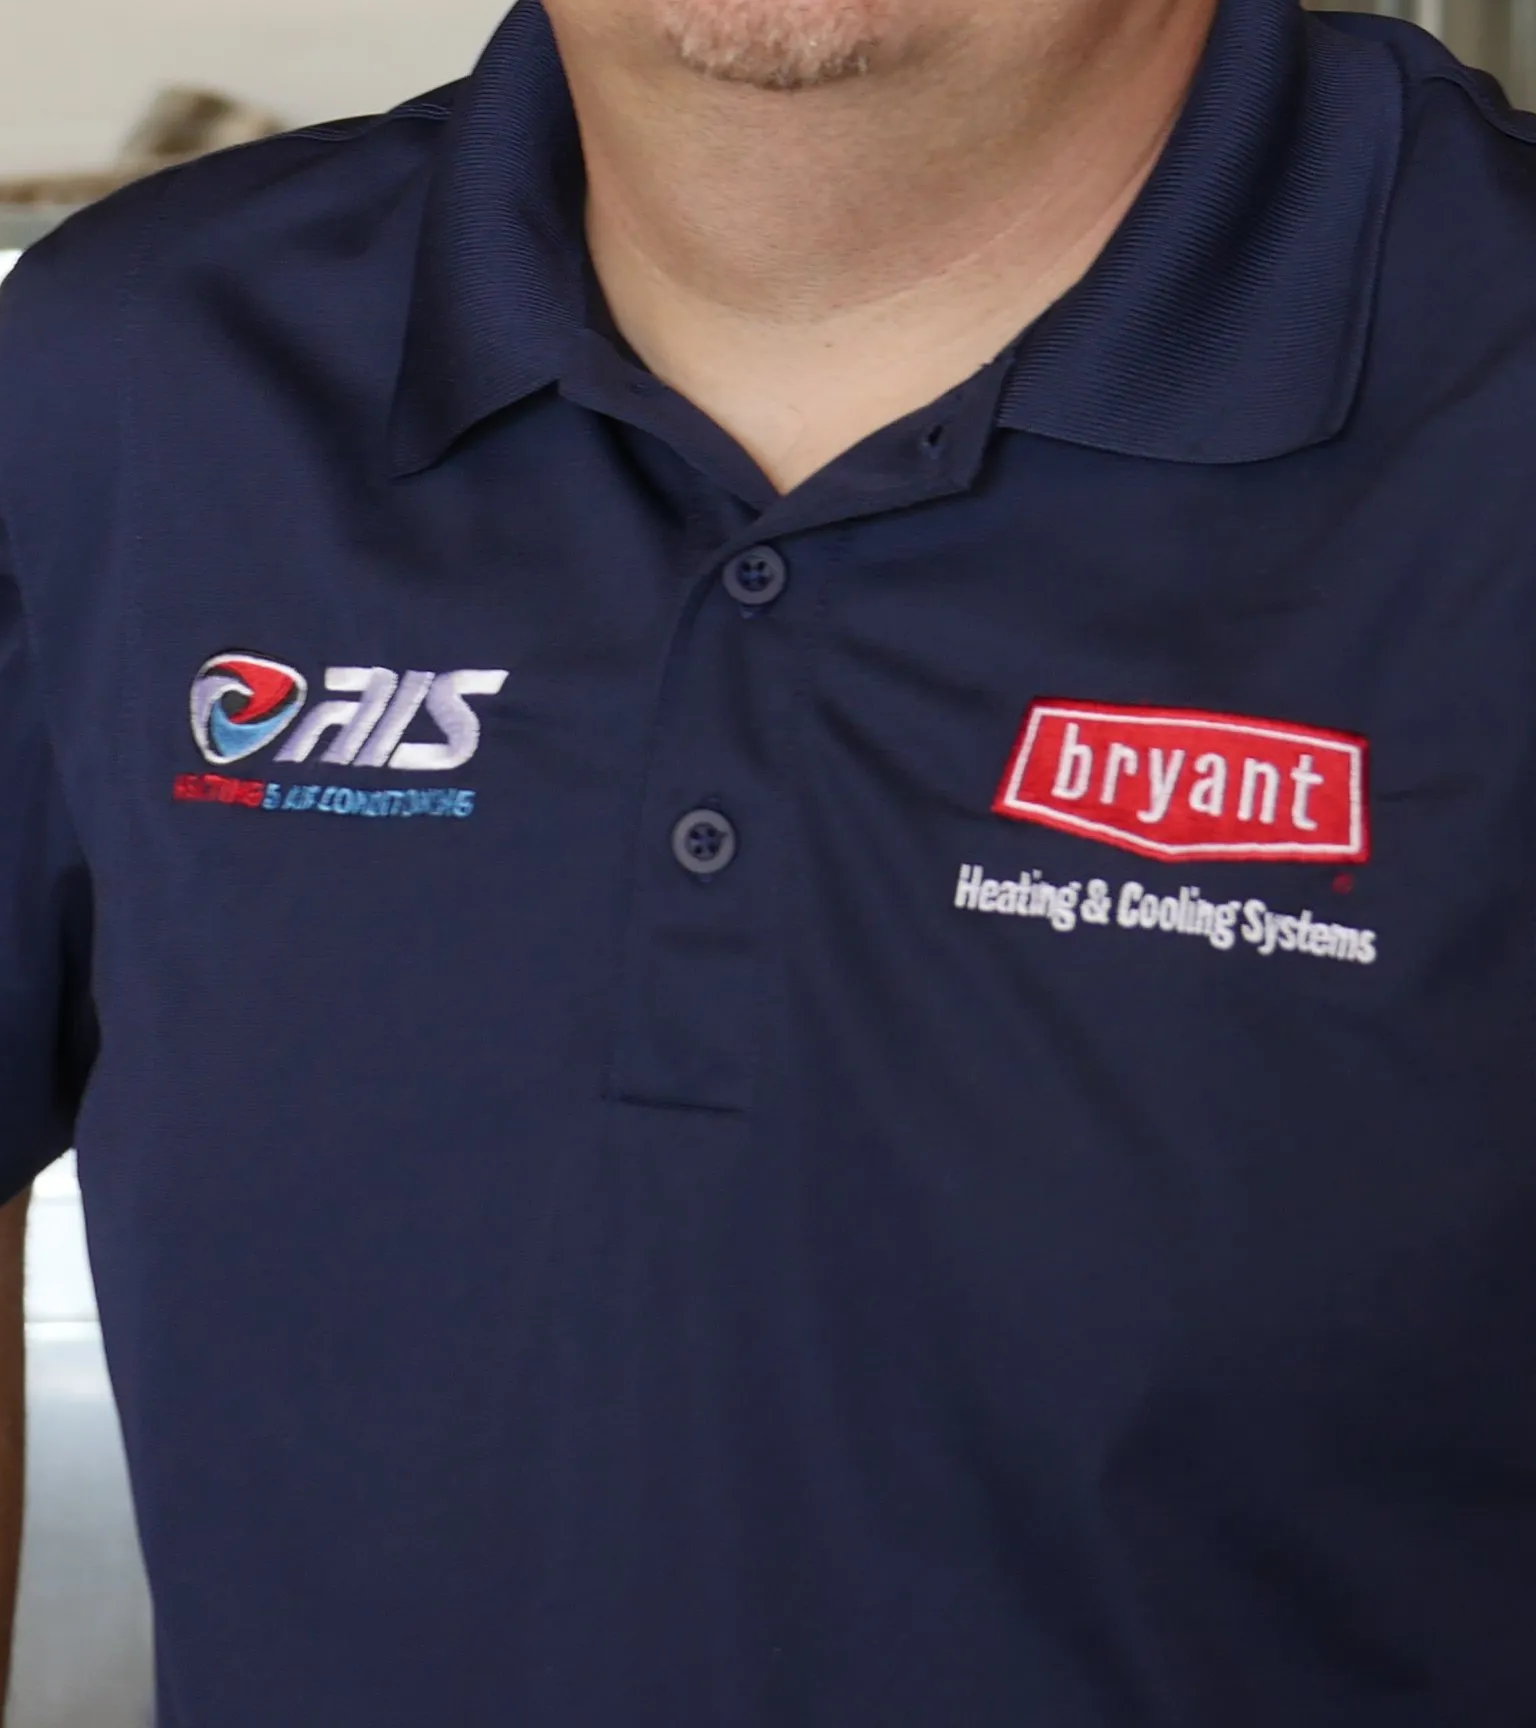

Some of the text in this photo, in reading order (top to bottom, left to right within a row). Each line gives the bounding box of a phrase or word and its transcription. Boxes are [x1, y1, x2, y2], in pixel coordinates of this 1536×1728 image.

[1051, 722, 1324, 830] bryant
[955, 864, 1377, 964] Heating & Cooling Systems
